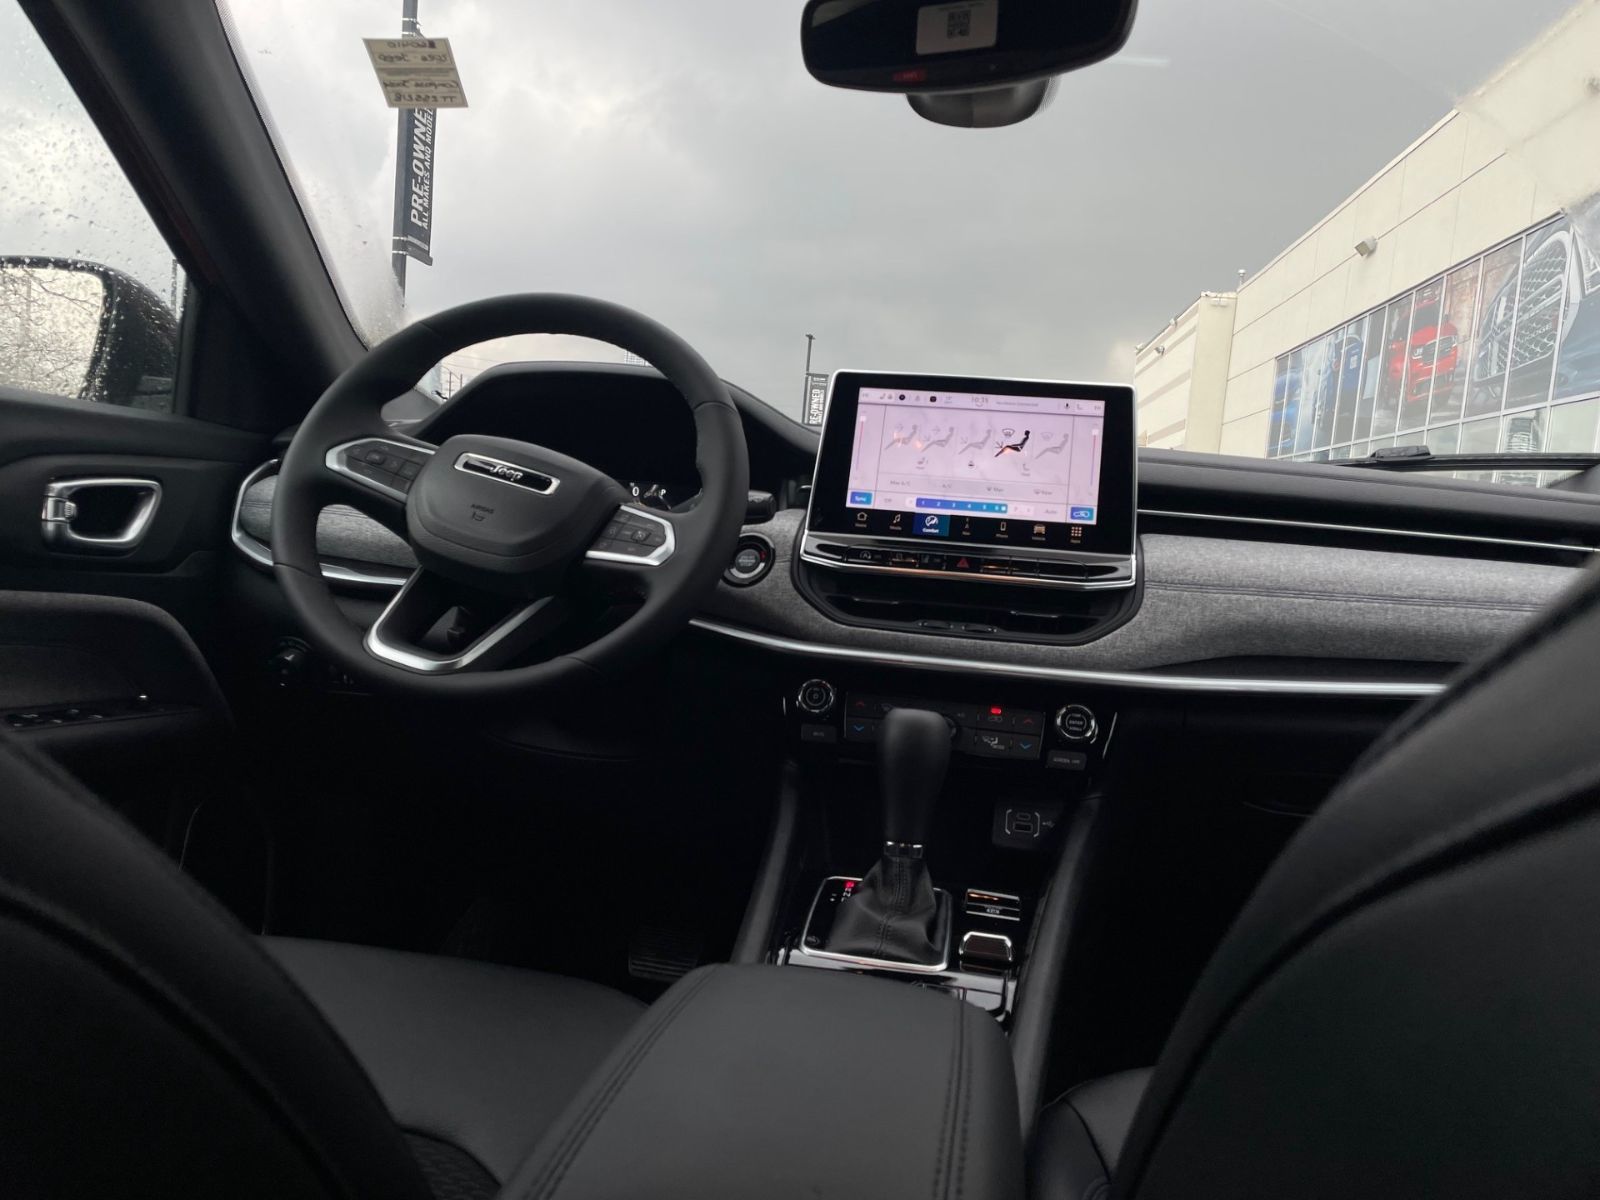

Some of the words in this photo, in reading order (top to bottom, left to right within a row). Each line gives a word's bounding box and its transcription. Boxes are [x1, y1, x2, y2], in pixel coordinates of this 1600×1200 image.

[425, 108, 433, 144] MODEL
[410, 108, 427, 227] PRE-OWNE
[422, 172, 430, 208] MAKES
[809, 389, 821, 424] RE-OWNED
[490, 465, 523, 481] Jeep
